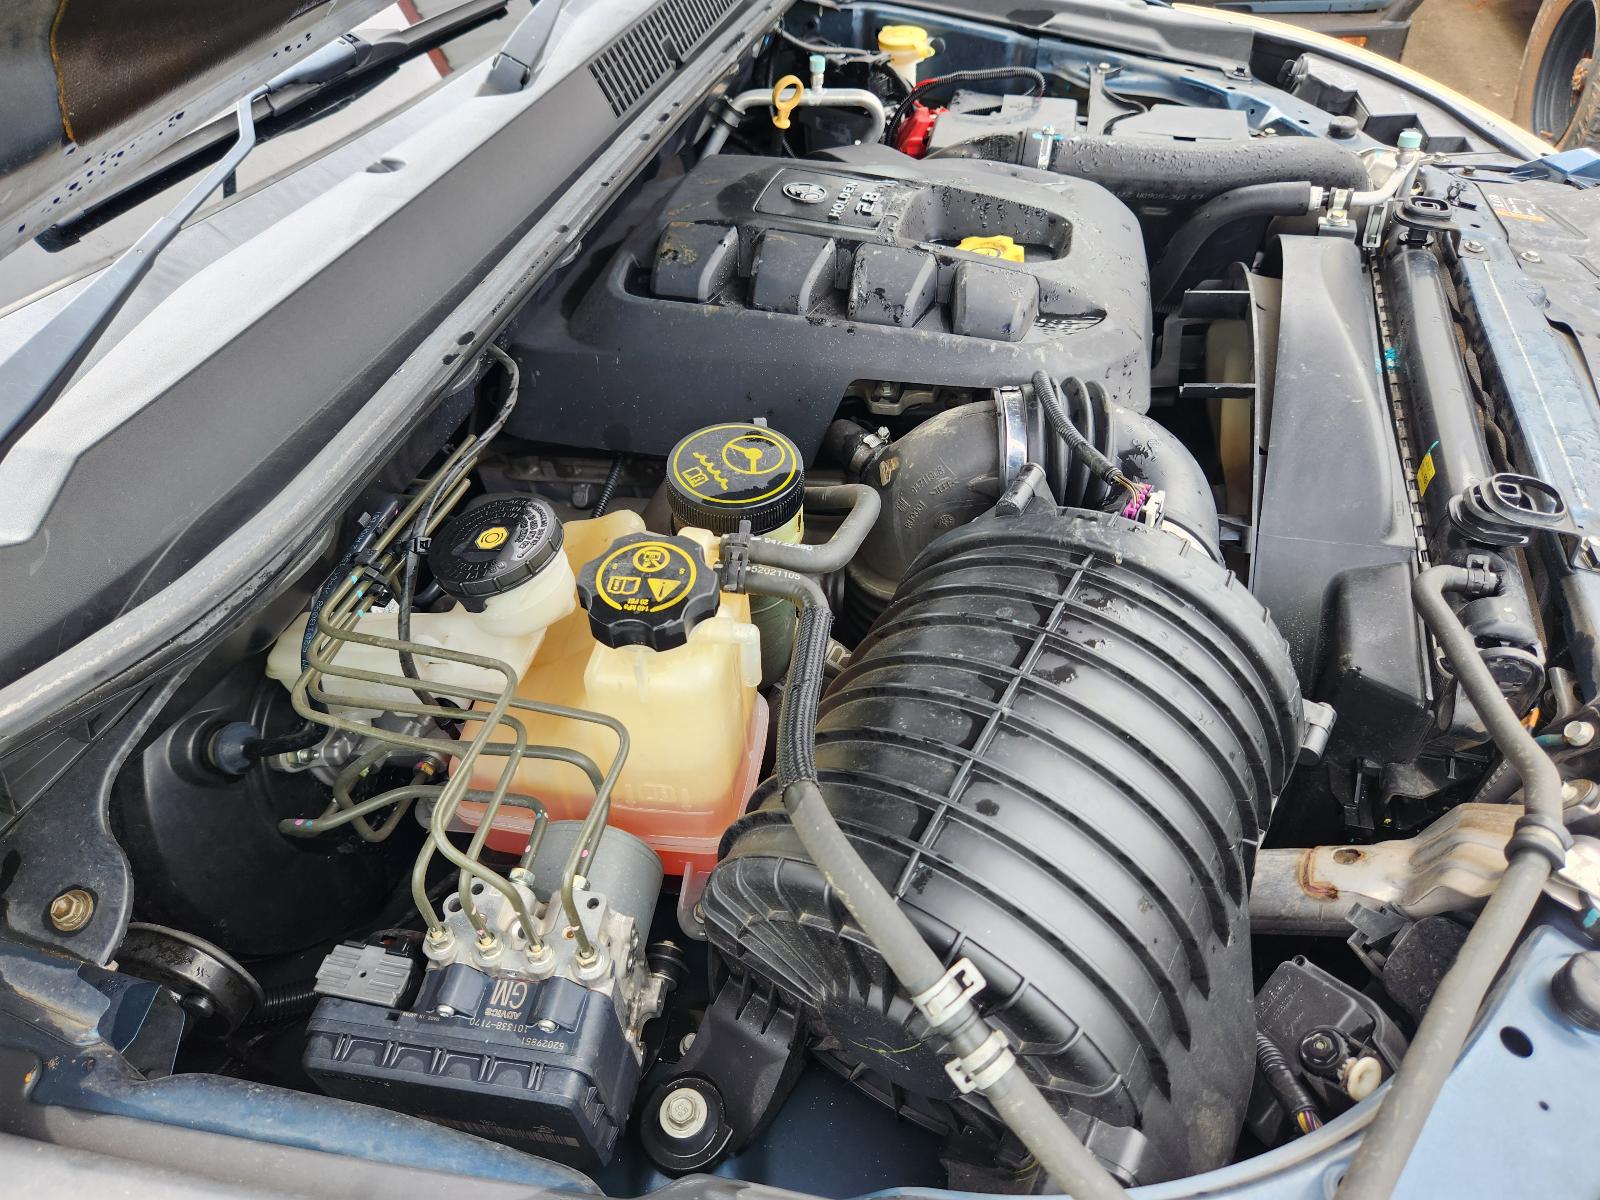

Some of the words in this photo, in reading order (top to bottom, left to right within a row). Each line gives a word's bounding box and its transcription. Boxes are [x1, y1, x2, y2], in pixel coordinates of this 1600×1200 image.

[828, 181, 858, 218] HOLDEN
[751, 565, 801, 580] 52021105
[490, 979, 528, 1010] GM
[484, 1007, 522, 1020] ADVICS
